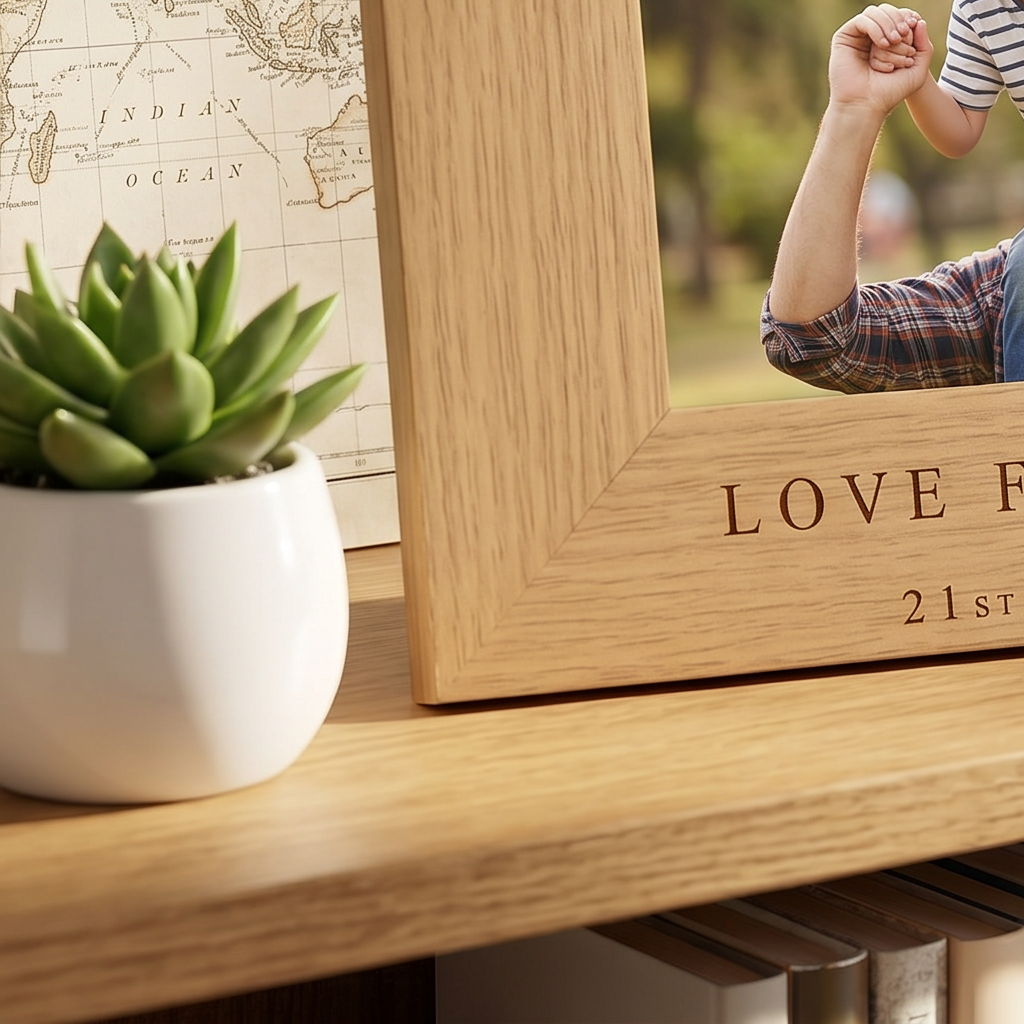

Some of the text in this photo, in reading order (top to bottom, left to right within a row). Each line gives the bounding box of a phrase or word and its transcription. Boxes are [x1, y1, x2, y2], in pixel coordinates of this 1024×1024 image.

[99, 97, 243, 125] INDIAN
[125, 163, 244, 189] OCEAN
[720, 467, 947, 537] LOVE
